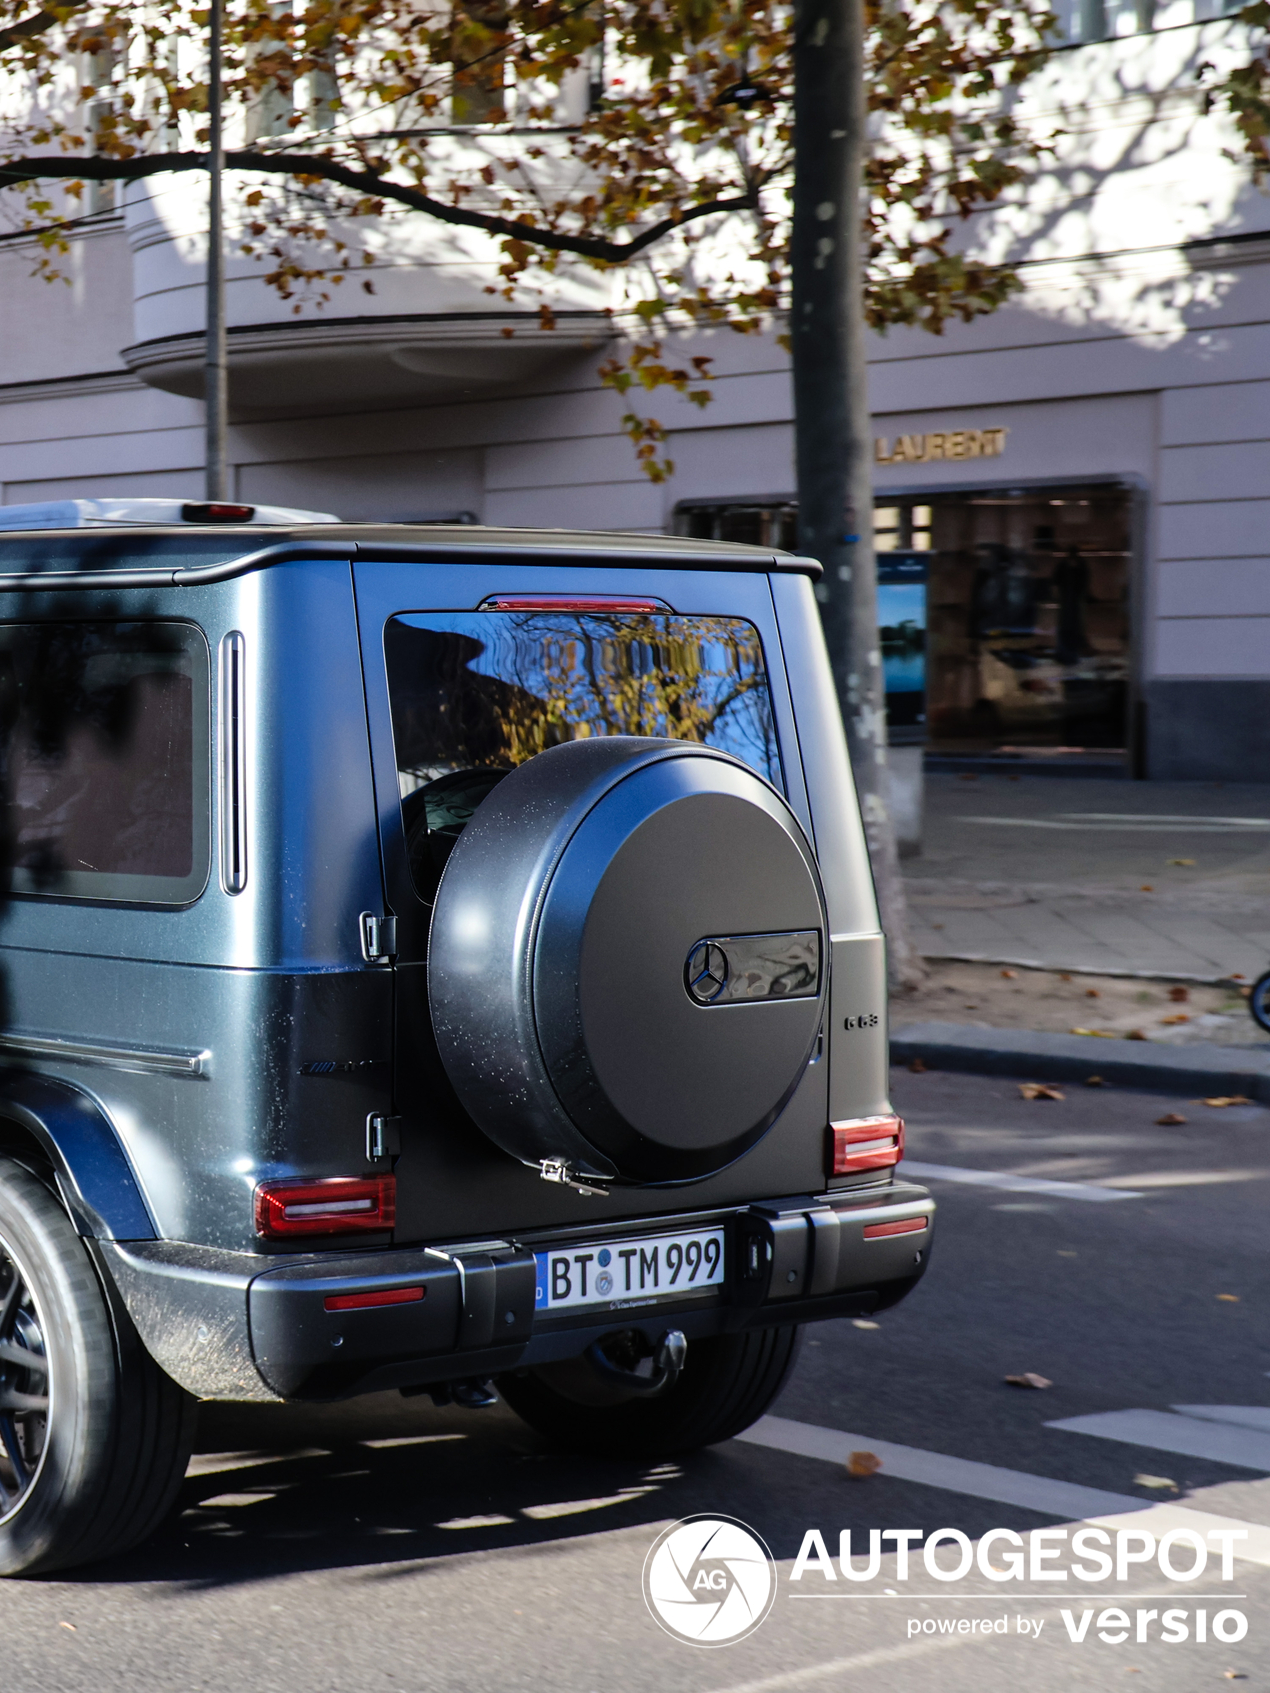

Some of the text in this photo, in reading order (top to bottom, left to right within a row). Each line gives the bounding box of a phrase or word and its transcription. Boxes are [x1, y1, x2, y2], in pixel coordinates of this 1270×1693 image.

[875, 428, 1008, 464] LAURENT
[551, 1237, 721, 1301] BT TM 999
